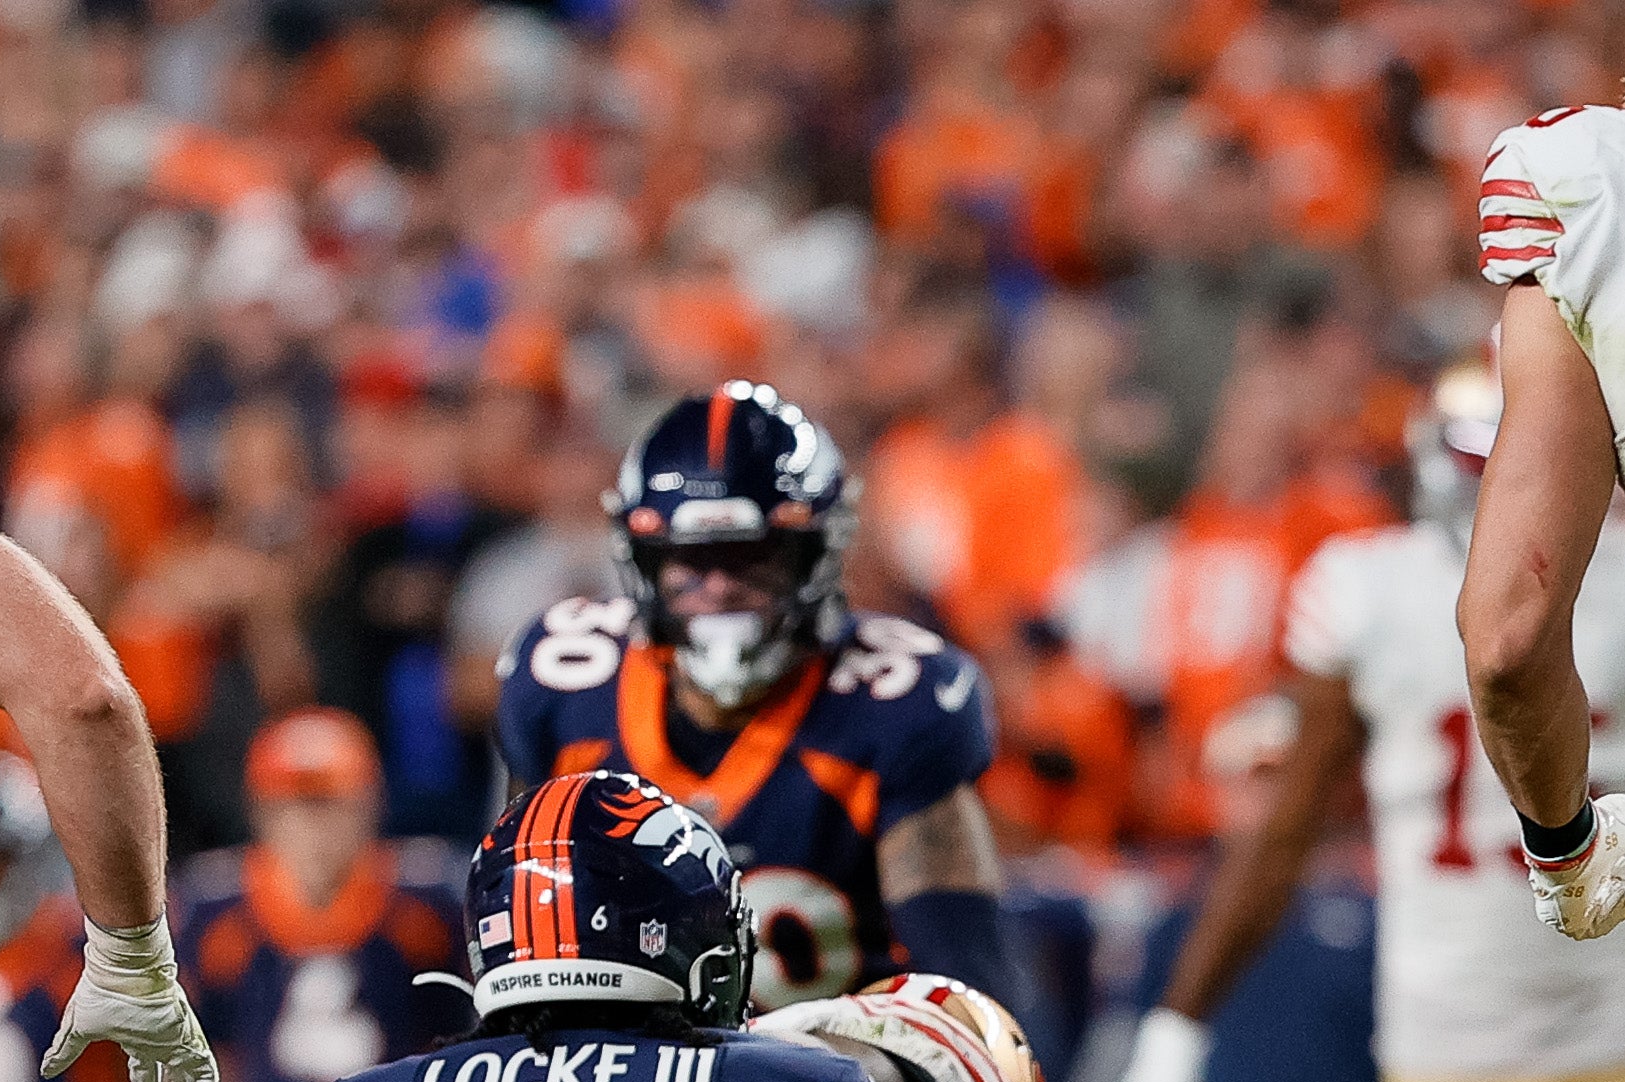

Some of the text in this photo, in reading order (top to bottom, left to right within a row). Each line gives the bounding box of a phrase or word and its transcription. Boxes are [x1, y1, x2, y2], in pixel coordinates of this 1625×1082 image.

[590, 905, 608, 932] 6
[490, 972, 624, 995] INSPIRE CHANGE
